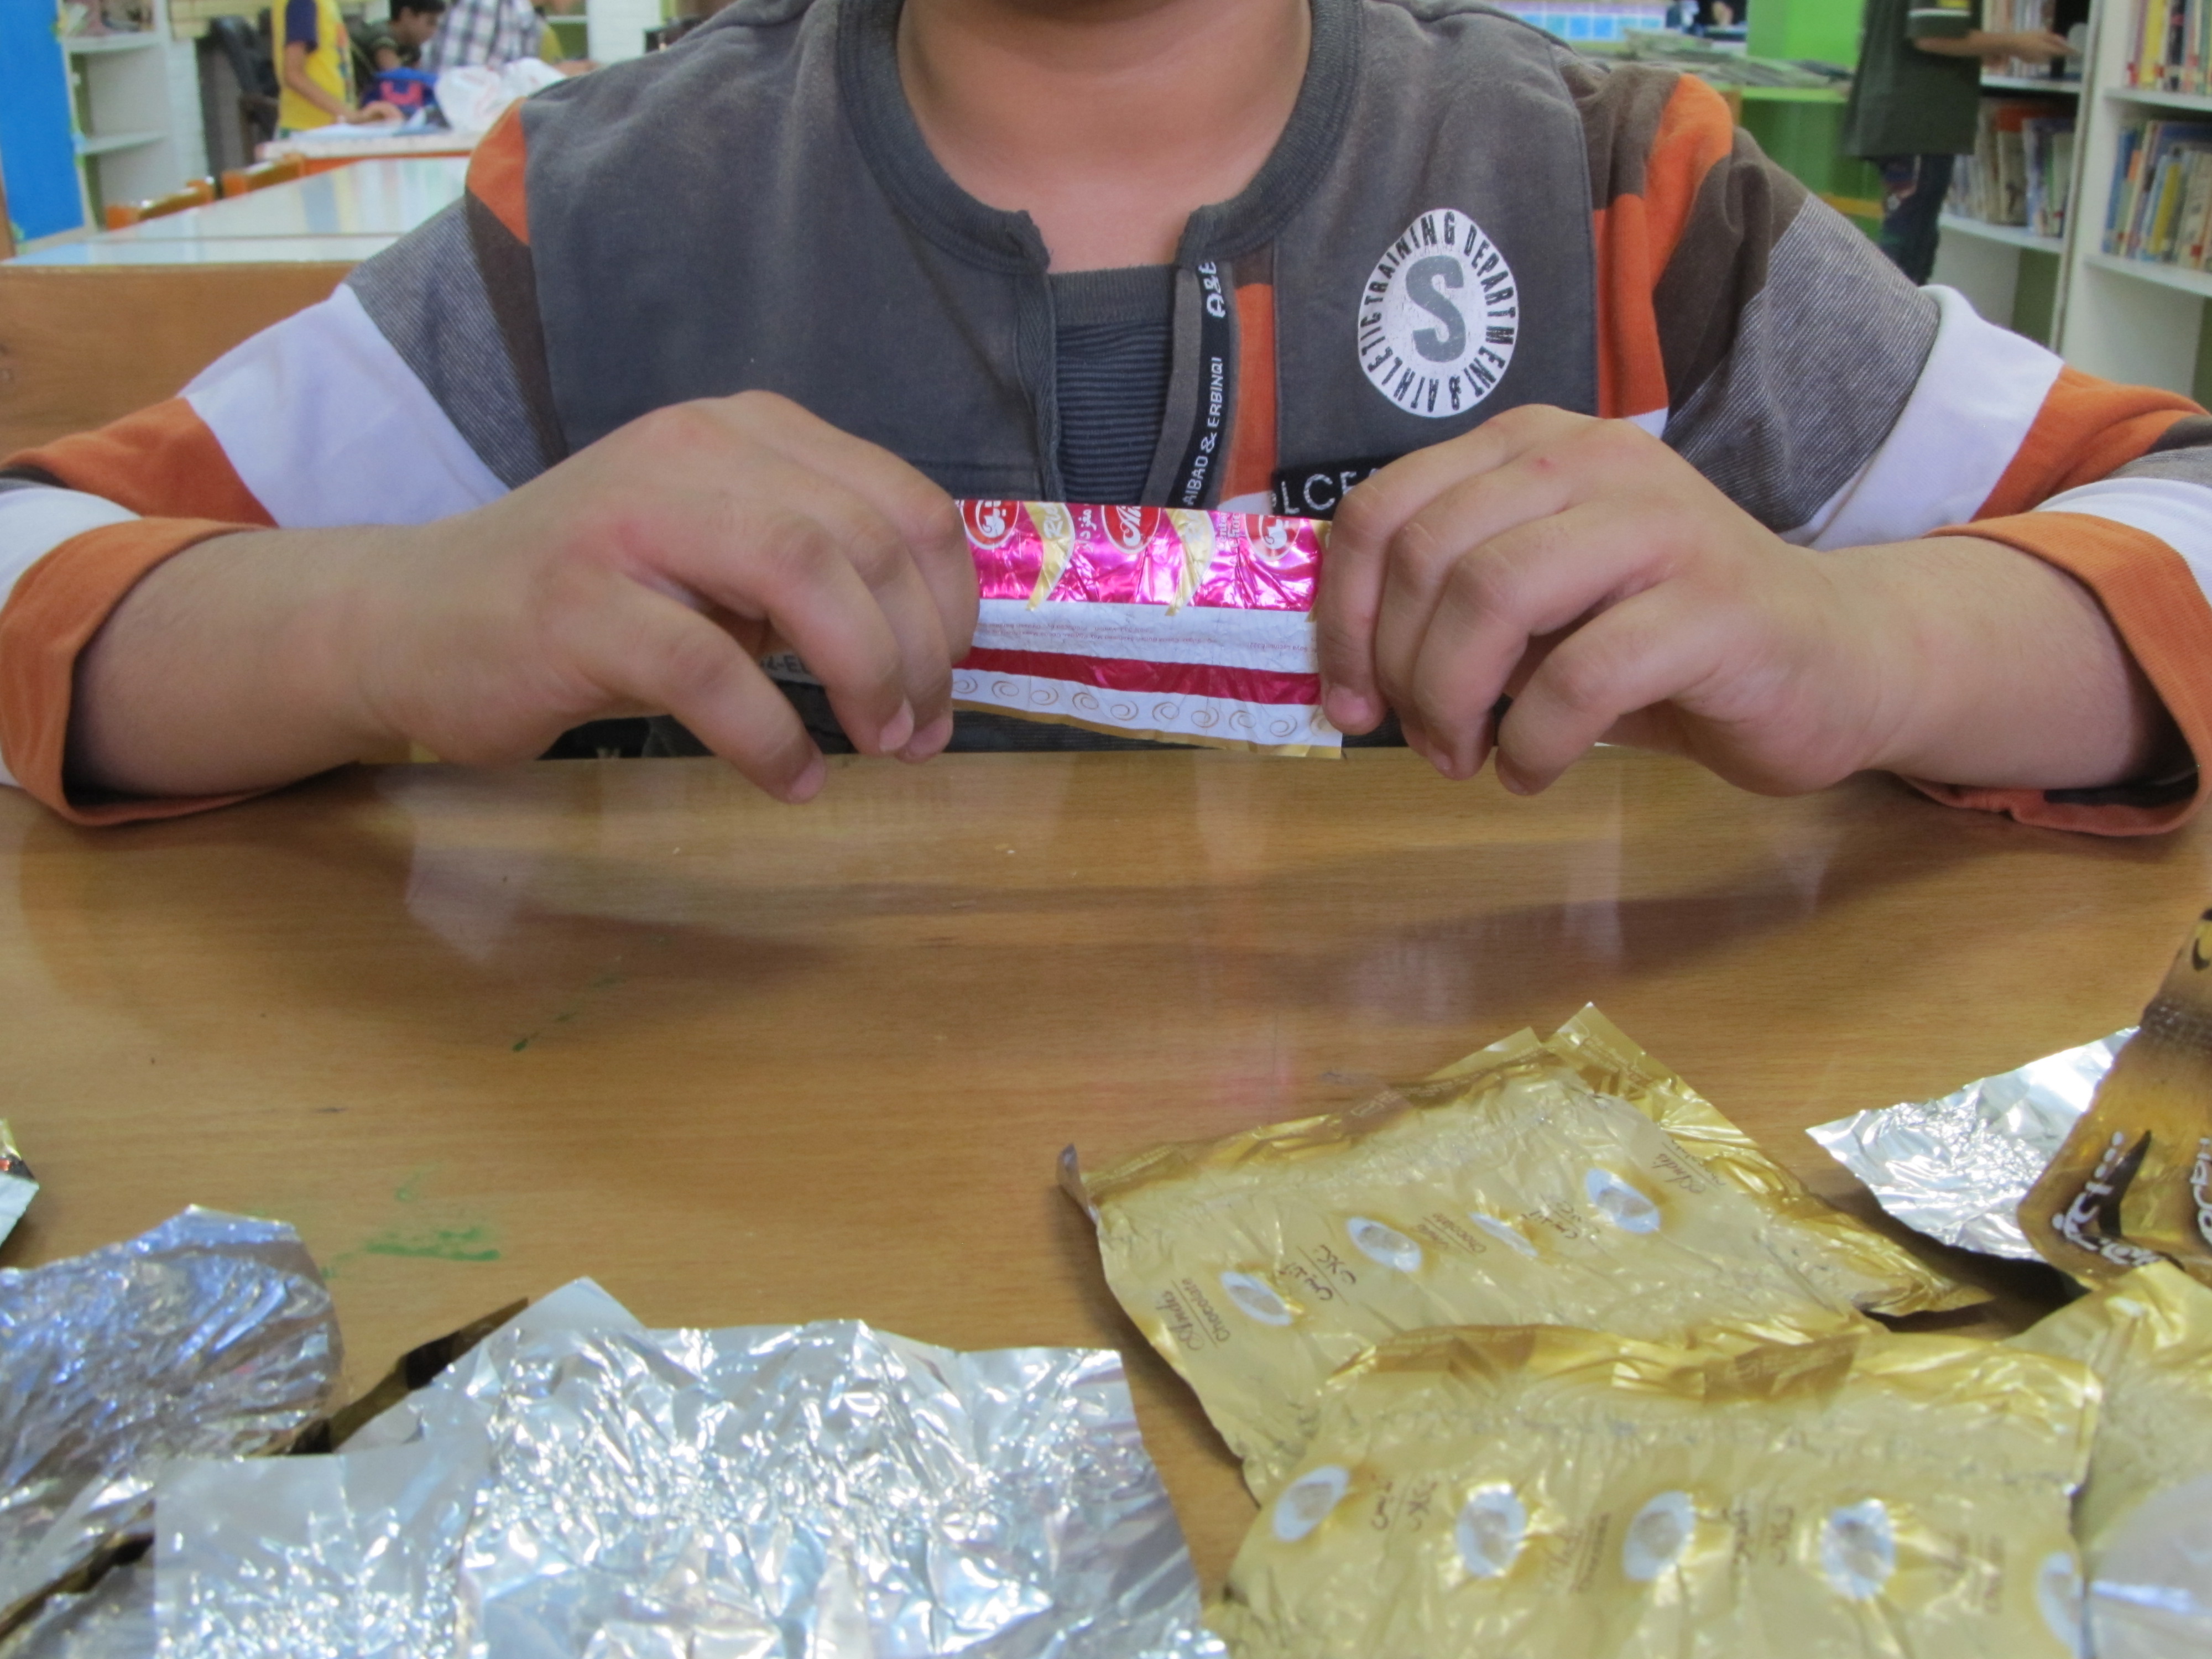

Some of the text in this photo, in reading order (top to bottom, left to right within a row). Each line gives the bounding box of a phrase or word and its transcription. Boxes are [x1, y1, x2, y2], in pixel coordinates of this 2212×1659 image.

[1364, 211, 1455, 306] TRAINING
[1463, 223, 1516, 398] DEPARTMENT
[1405, 254, 1466, 363] S
